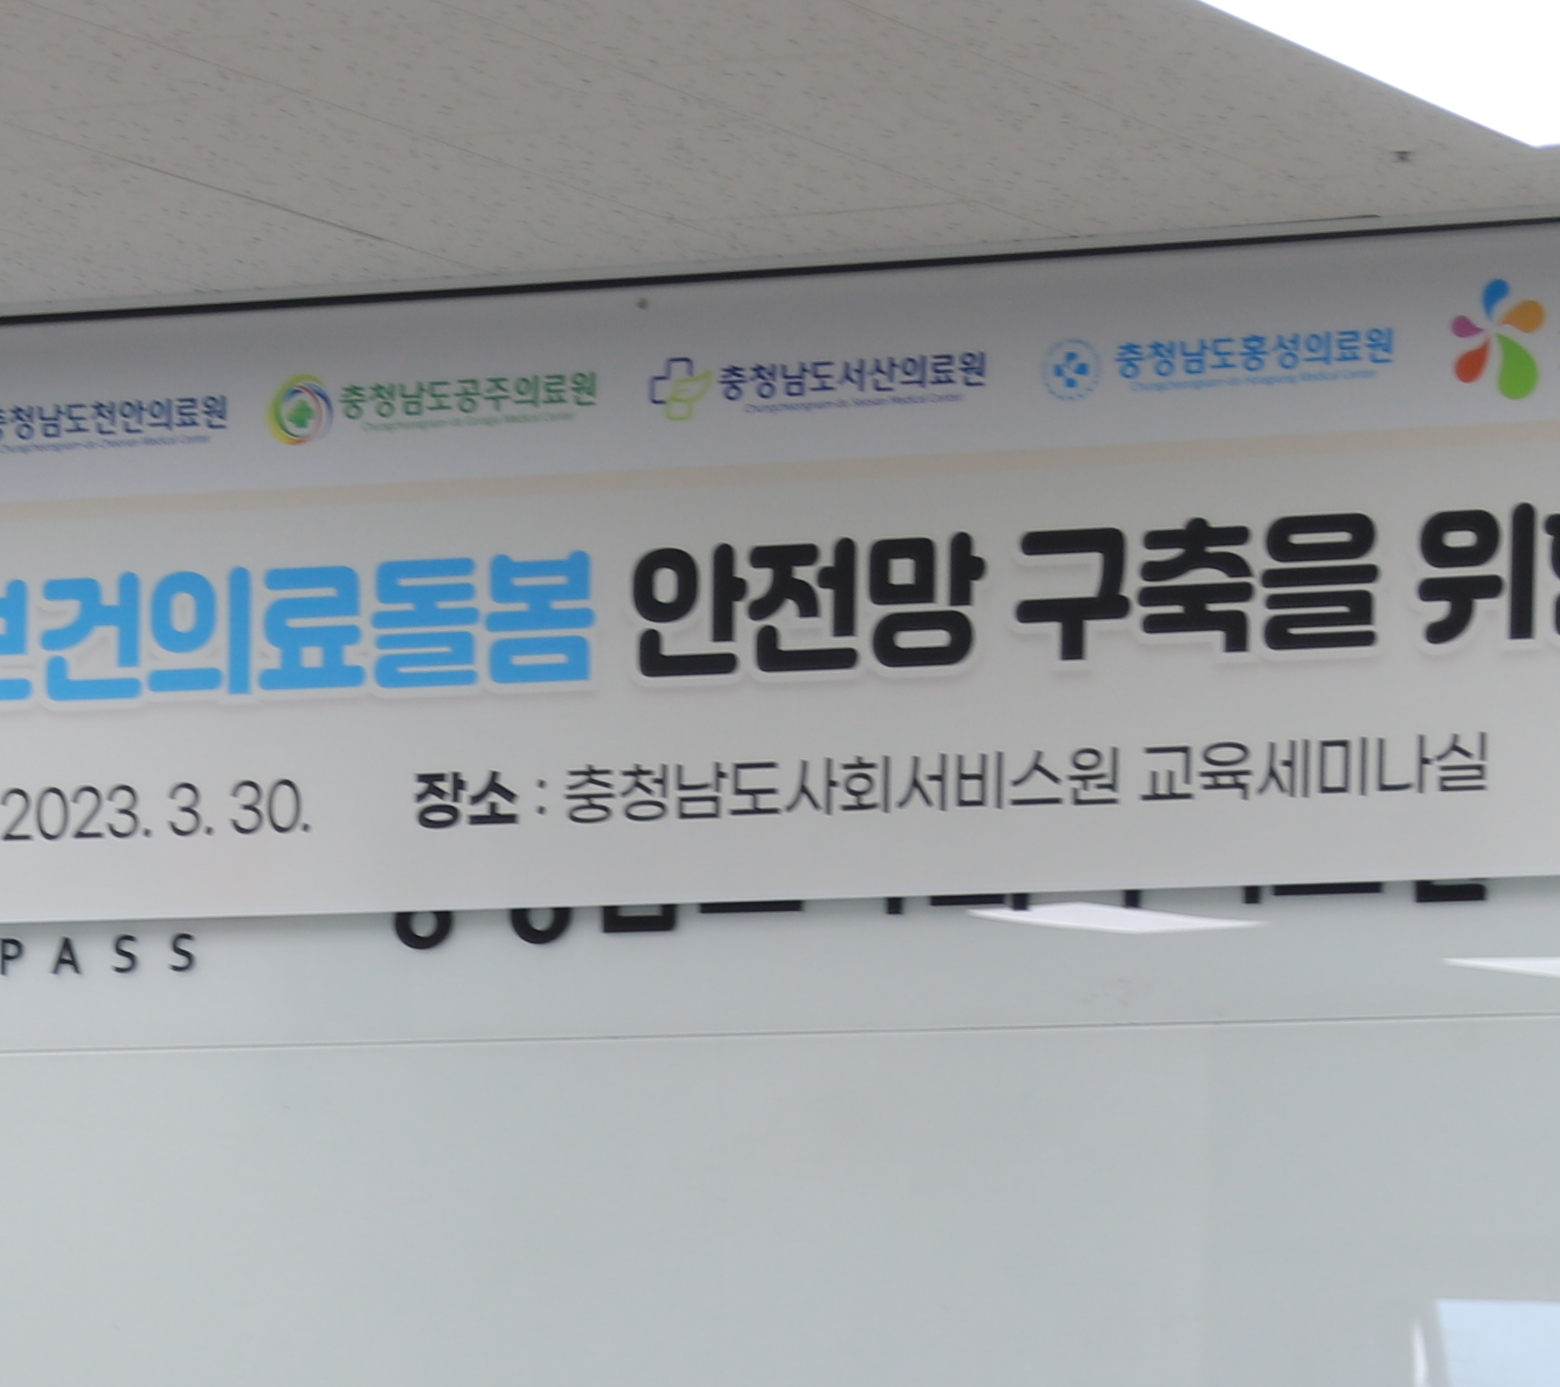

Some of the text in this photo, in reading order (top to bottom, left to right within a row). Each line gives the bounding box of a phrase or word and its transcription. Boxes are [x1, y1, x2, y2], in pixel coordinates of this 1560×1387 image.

[719, 351, 986, 401] 충청남도서산의료원
[1115, 327, 1394, 379] 충청남도홍성의료원
[339, 371, 597, 420] 충청남도공주의료원
[632, 532, 987, 678] 안전망
[1014, 512, 1380, 661] 구축을
[0, 783, 152, 842] 2023.
[168, 781, 214, 838] 3.
[230, 778, 311, 835] 30.
[564, 745, 1121, 825] 충청남도사회서비스원
[1138, 730, 1488, 803] 교육세미나실
